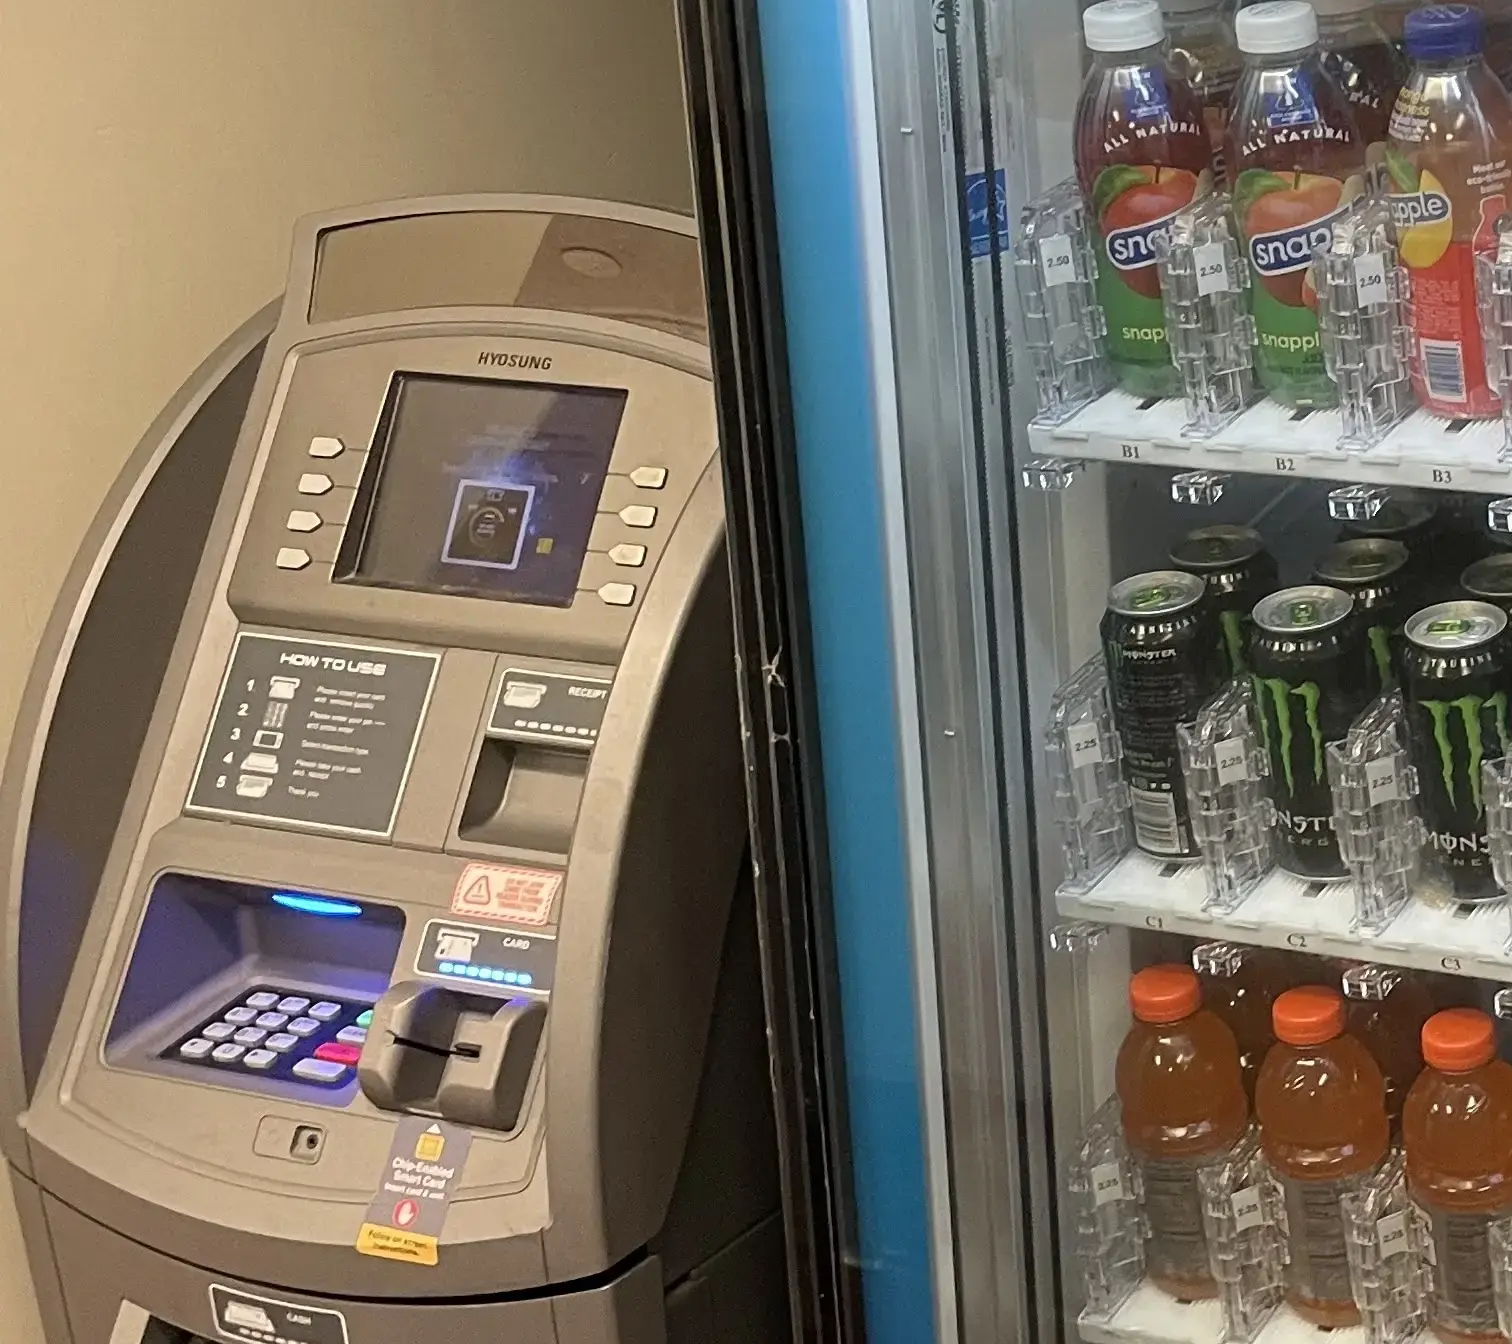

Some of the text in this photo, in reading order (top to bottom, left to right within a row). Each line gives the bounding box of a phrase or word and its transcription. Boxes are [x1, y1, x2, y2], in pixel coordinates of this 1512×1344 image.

[1104, 122, 1201, 153] ALL NATURAL
[1242, 128, 1350, 156] ALL NATURAL
[1047, 255, 1070, 268] 2.50
[1200, 264, 1222, 277] 2.50
[1360, 274, 1381, 287] 2.50
[478, 351, 552, 370] HYOSUNG
[1122, 445, 1140, 459] B1
[1275, 458, 1295, 472] B2
[1432, 469, 1452, 484] B3
[280, 652, 387, 676] HOW TO USE
[247, 679, 255, 692] 1
[568, 686, 607, 699] RECEIPT
[237, 703, 249, 716] 2
[230, 728, 241, 740] 3
[1075, 739, 1097, 752] 2.25
[223, 752, 234, 764] 4
[1221, 756, 1242, 770] 2.25
[216, 775, 227, 788] 5
[1372, 777, 1393, 789] 2.25
[1145, 916, 1163, 929] C1
[503, 937, 531, 950] CARD
[1287, 934, 1308, 948] C2
[1441, 957, 1461, 970] C3
[392, 1157, 455, 1179] Chip-Enabled
[393, 1169, 447, 1189] Smart Card
[368, 1230, 390, 1242] Follow
